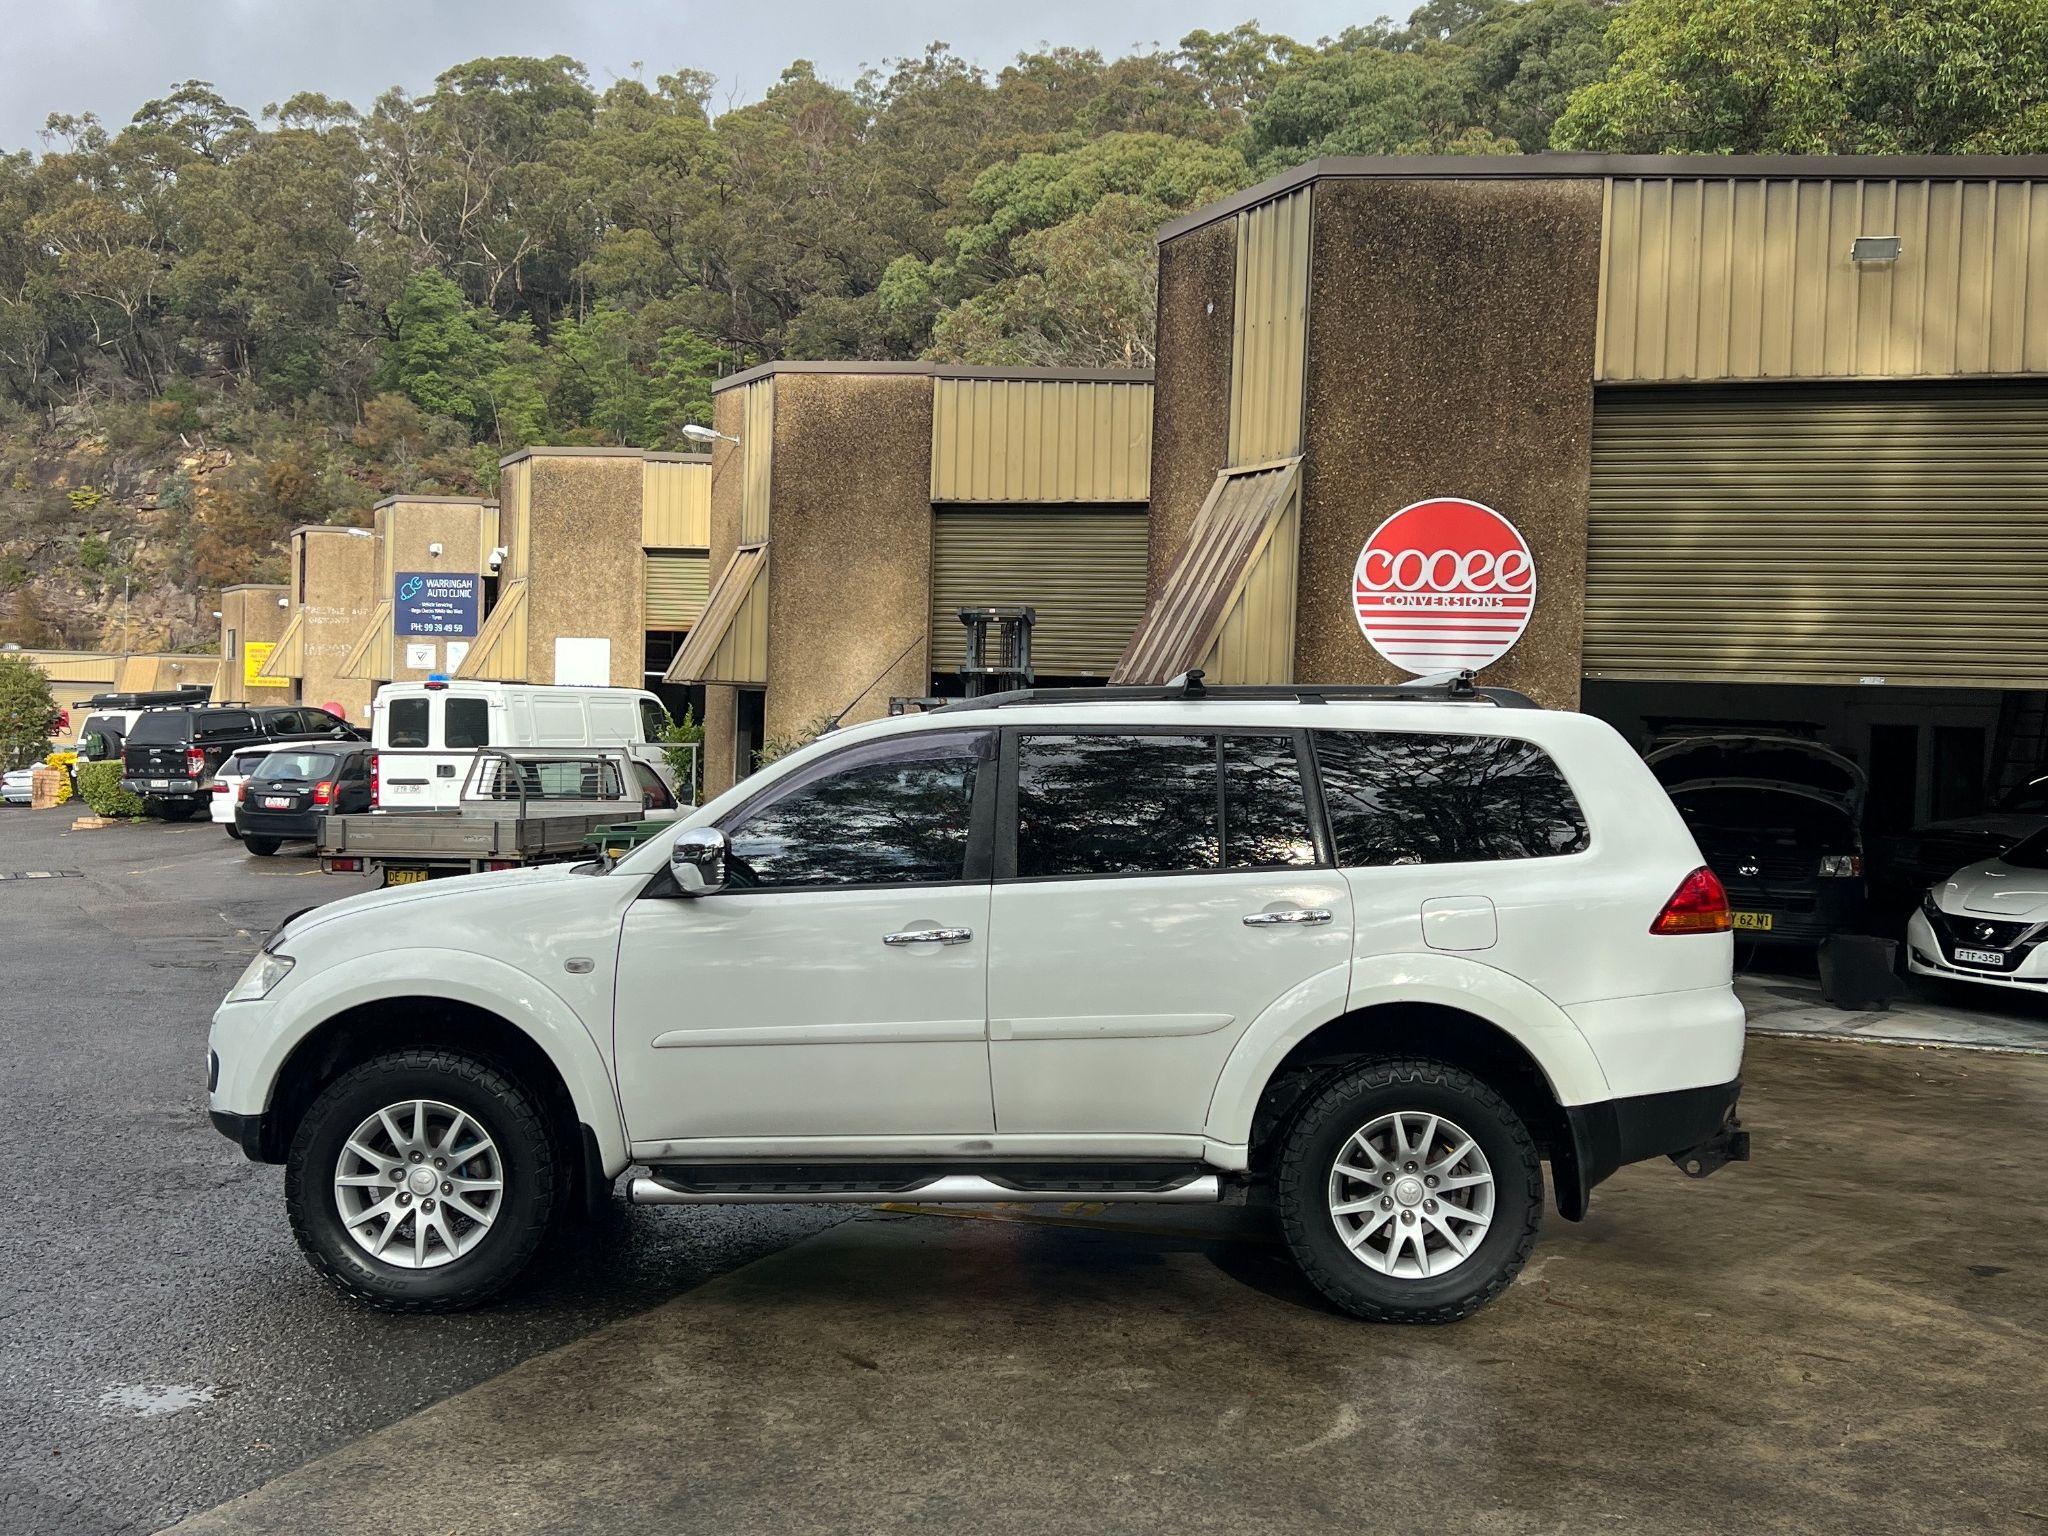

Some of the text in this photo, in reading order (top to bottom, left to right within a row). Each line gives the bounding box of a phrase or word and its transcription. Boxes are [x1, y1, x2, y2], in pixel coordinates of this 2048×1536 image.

[1358, 549, 1533, 592] cooee
[426, 579, 473, 588] WARRINGAH
[427, 589, 472, 598] AUTO CLINIC
[1382, 595, 1505, 607] CONVERSIONS
[411, 623, 463, 632] PH: 99 39 49 59
[390, 871, 400, 882] DE
[403, 872, 413, 882] 77
[1740, 914, 1753, 926] 62
[1959, 950, 1977, 961] FTF
